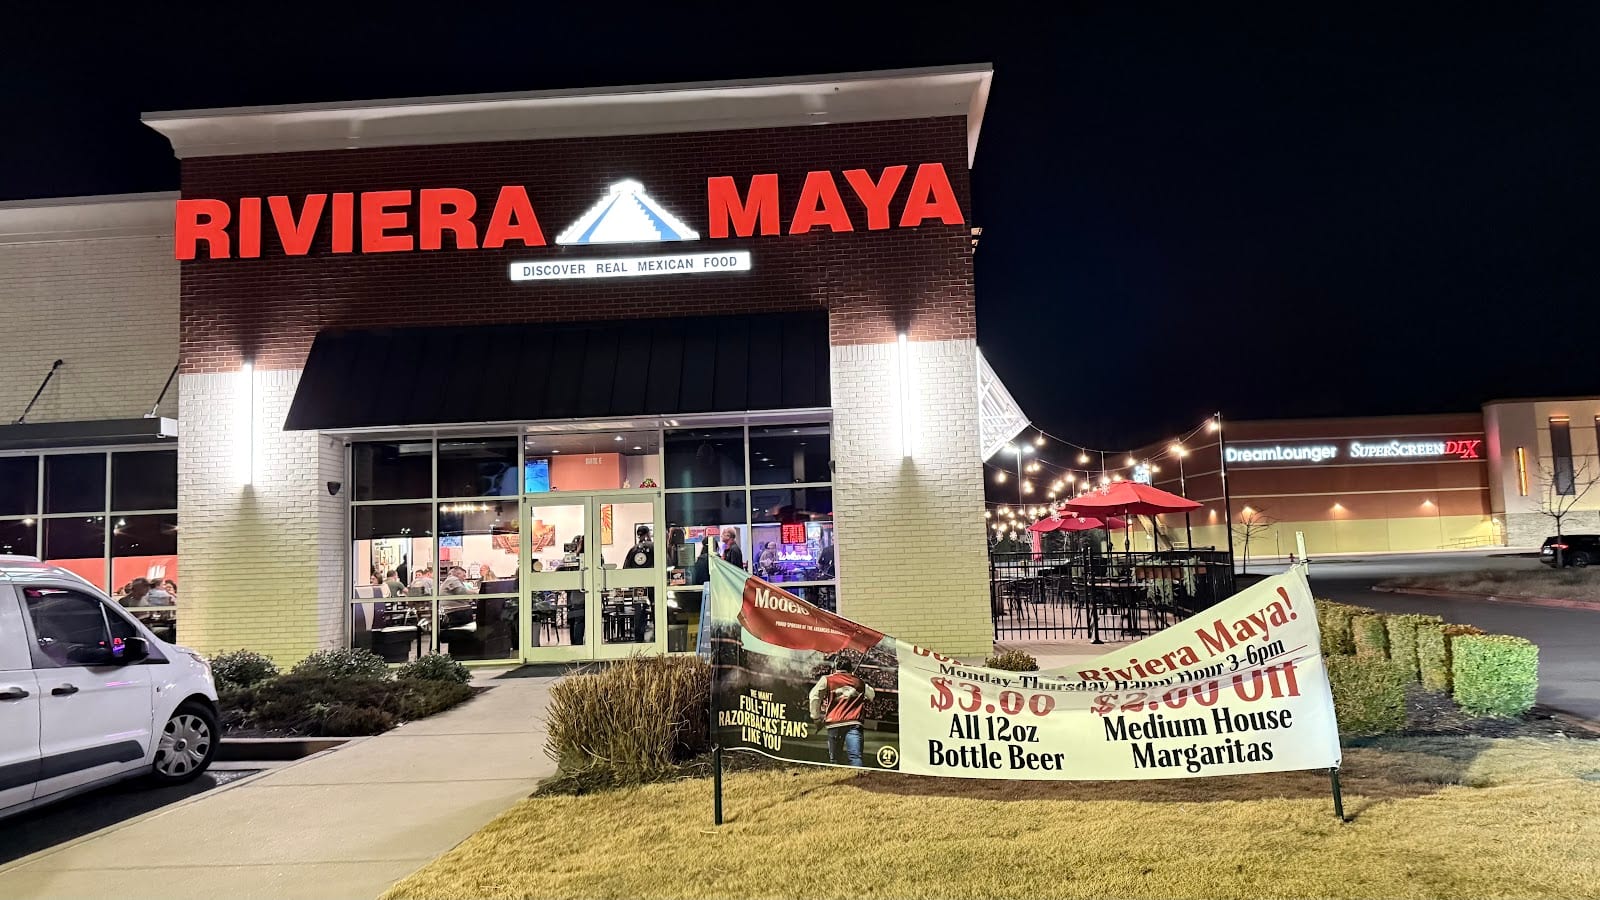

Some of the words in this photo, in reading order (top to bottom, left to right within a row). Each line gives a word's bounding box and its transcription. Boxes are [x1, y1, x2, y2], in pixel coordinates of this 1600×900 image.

[175, 185, 547, 260] RIVIERA
[708, 163, 965, 238] MAYA
[523, 264, 586, 277] DISCOVER
[596, 262, 628, 273] REAL
[638, 258, 694, 272] MEXICAN
[704, 256, 738, 268] FOOD
[1226, 445, 1337, 462] DreamLounger
[1077, 645, 1201, 681] Riviera
[1194, 587, 1297, 657] Maya!
[1225, 640, 1286, 666] 3-6pm
[740, 695, 787, 720] FULL-TIME
[758, 691, 773, 702] WANT
[930, 677, 1056, 716] $3.00
[781, 720, 808, 738] FANS
[949, 713, 980, 740] All
[985, 715, 1039, 742] 12oz
[1103, 713, 1208, 742] Medium
[1211, 707, 1293, 735] House
[742, 726, 762, 745] LIKE
[763, 732, 781, 751] YOU
[928, 739, 1002, 769] Bottle
[1008, 744, 1065, 770] Beer
[1131, 738, 1274, 774] Margaritas
